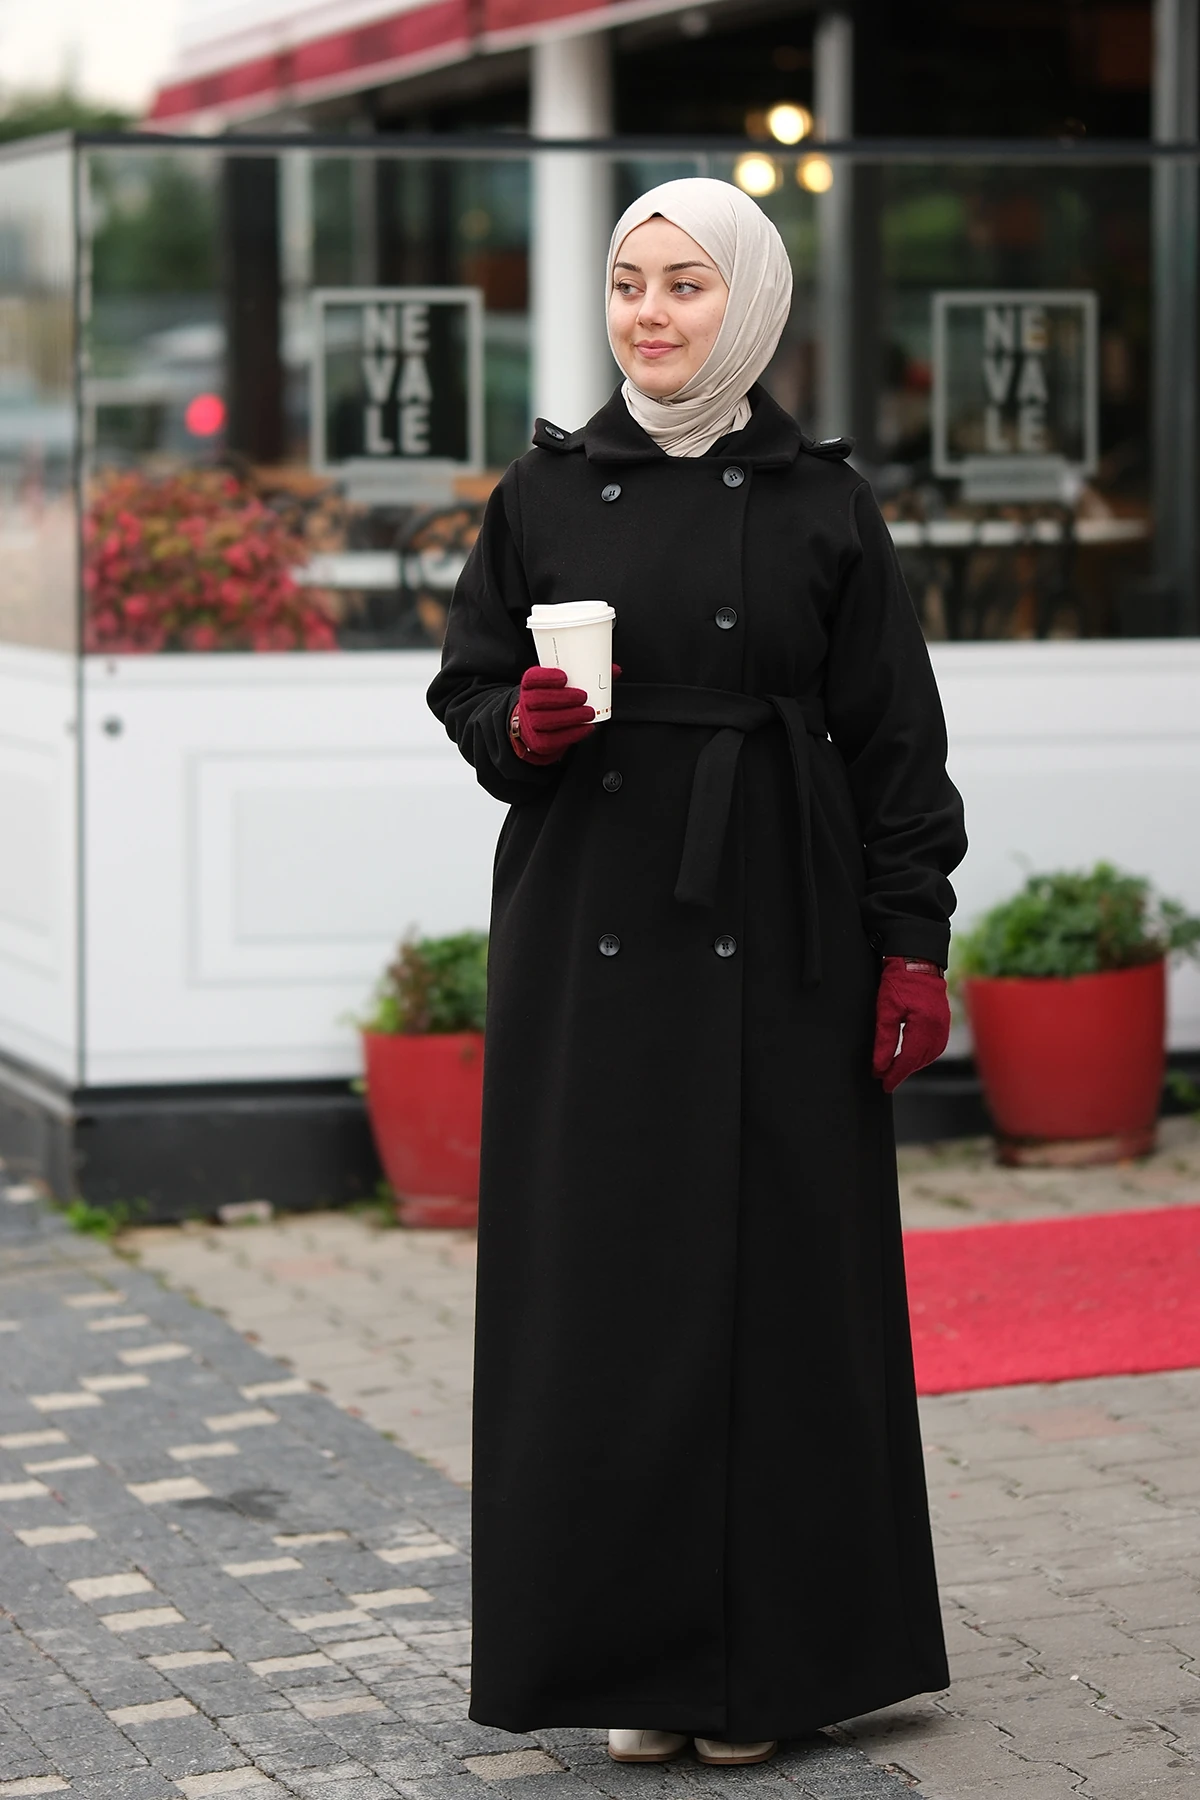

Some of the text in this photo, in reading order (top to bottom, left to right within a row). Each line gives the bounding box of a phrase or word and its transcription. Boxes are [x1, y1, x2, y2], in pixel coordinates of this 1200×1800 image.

[364, 304, 430, 352] NE
[984, 306, 1047, 352] NE
[362, 356, 432, 405] VA
[983, 356, 1048, 404] VA
[364, 405, 430, 454] LE
[984, 405, 1047, 452] LE
